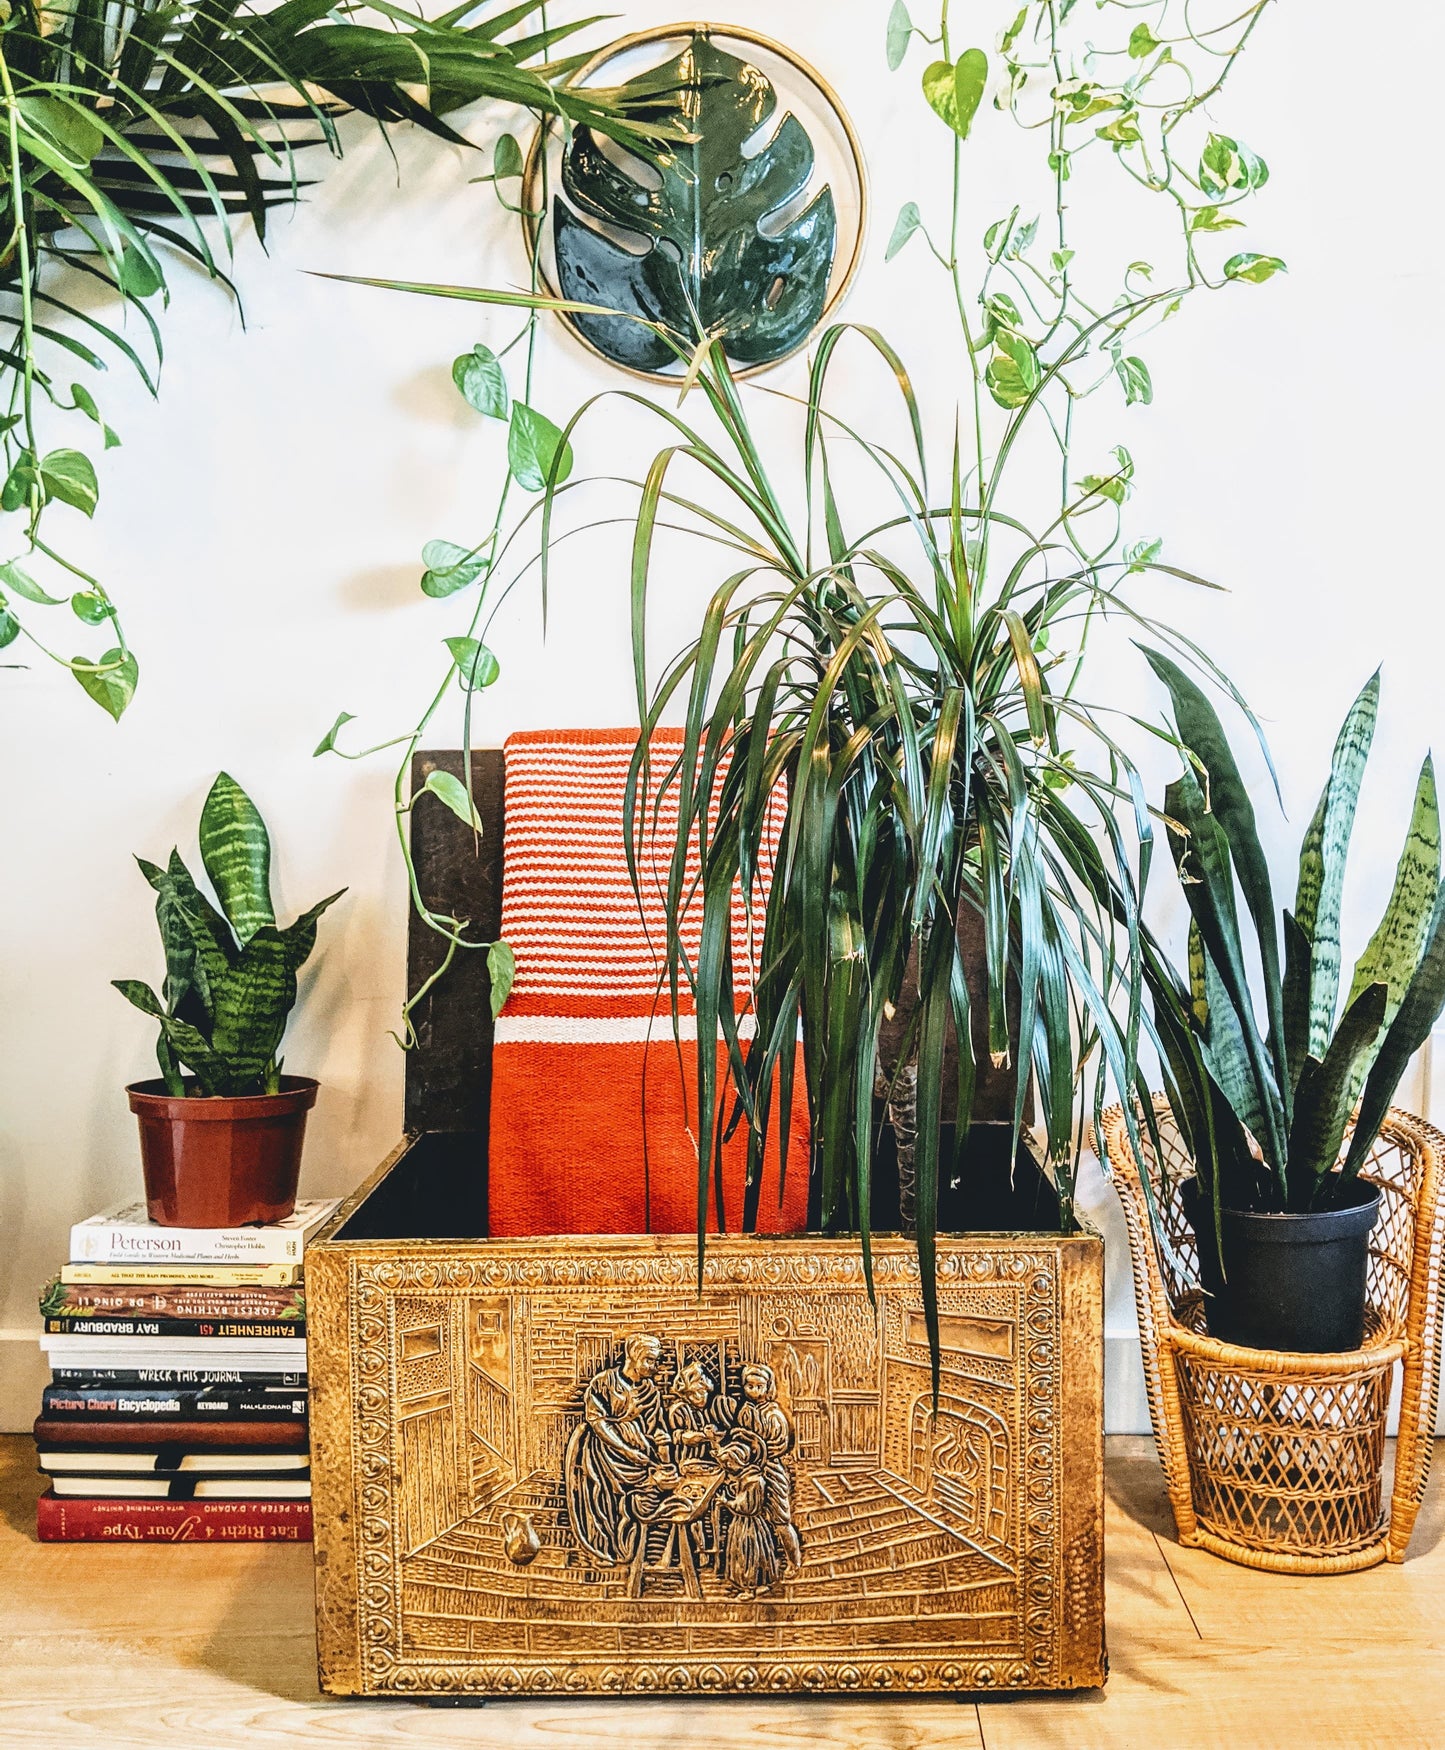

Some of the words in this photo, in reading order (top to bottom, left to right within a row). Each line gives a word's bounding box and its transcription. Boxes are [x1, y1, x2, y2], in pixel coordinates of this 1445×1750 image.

[111, 1232, 182, 1251] Peterson
[78, 1296, 90, 1306] LI
[94, 1297, 124, 1307] QING
[176, 1305, 228, 1315] BATHING
[234, 1306, 276, 1316] FOREST
[73, 1321, 134, 1334] BRADBURY
[136, 1323, 160, 1334] RAY
[200, 1324, 215, 1336] 451
[218, 1324, 295, 1336] FAHRENHEIT
[138, 1370, 172, 1382] WRECK
[176, 1370, 198, 1382] THIS
[200, 1370, 244, 1383] JOURNAL
[50, 1398, 86, 1410] Picture
[87, 1398, 117, 1410] Chord
[118, 1398, 180, 1413] Encyclopedia
[197, 1402, 229, 1410] KEYBOARD
[204, 1504, 247, 1512] D'ADAMO
[260, 1504, 291, 1512] PETER
[295, 1504, 310, 1512] DR.
[102, 1524, 144, 1540] Type
[146, 1516, 202, 1541] Your
[205, 1526, 215, 1538] 4
[220, 1524, 266, 1539] Right
[270, 1526, 298, 1538] Eat
